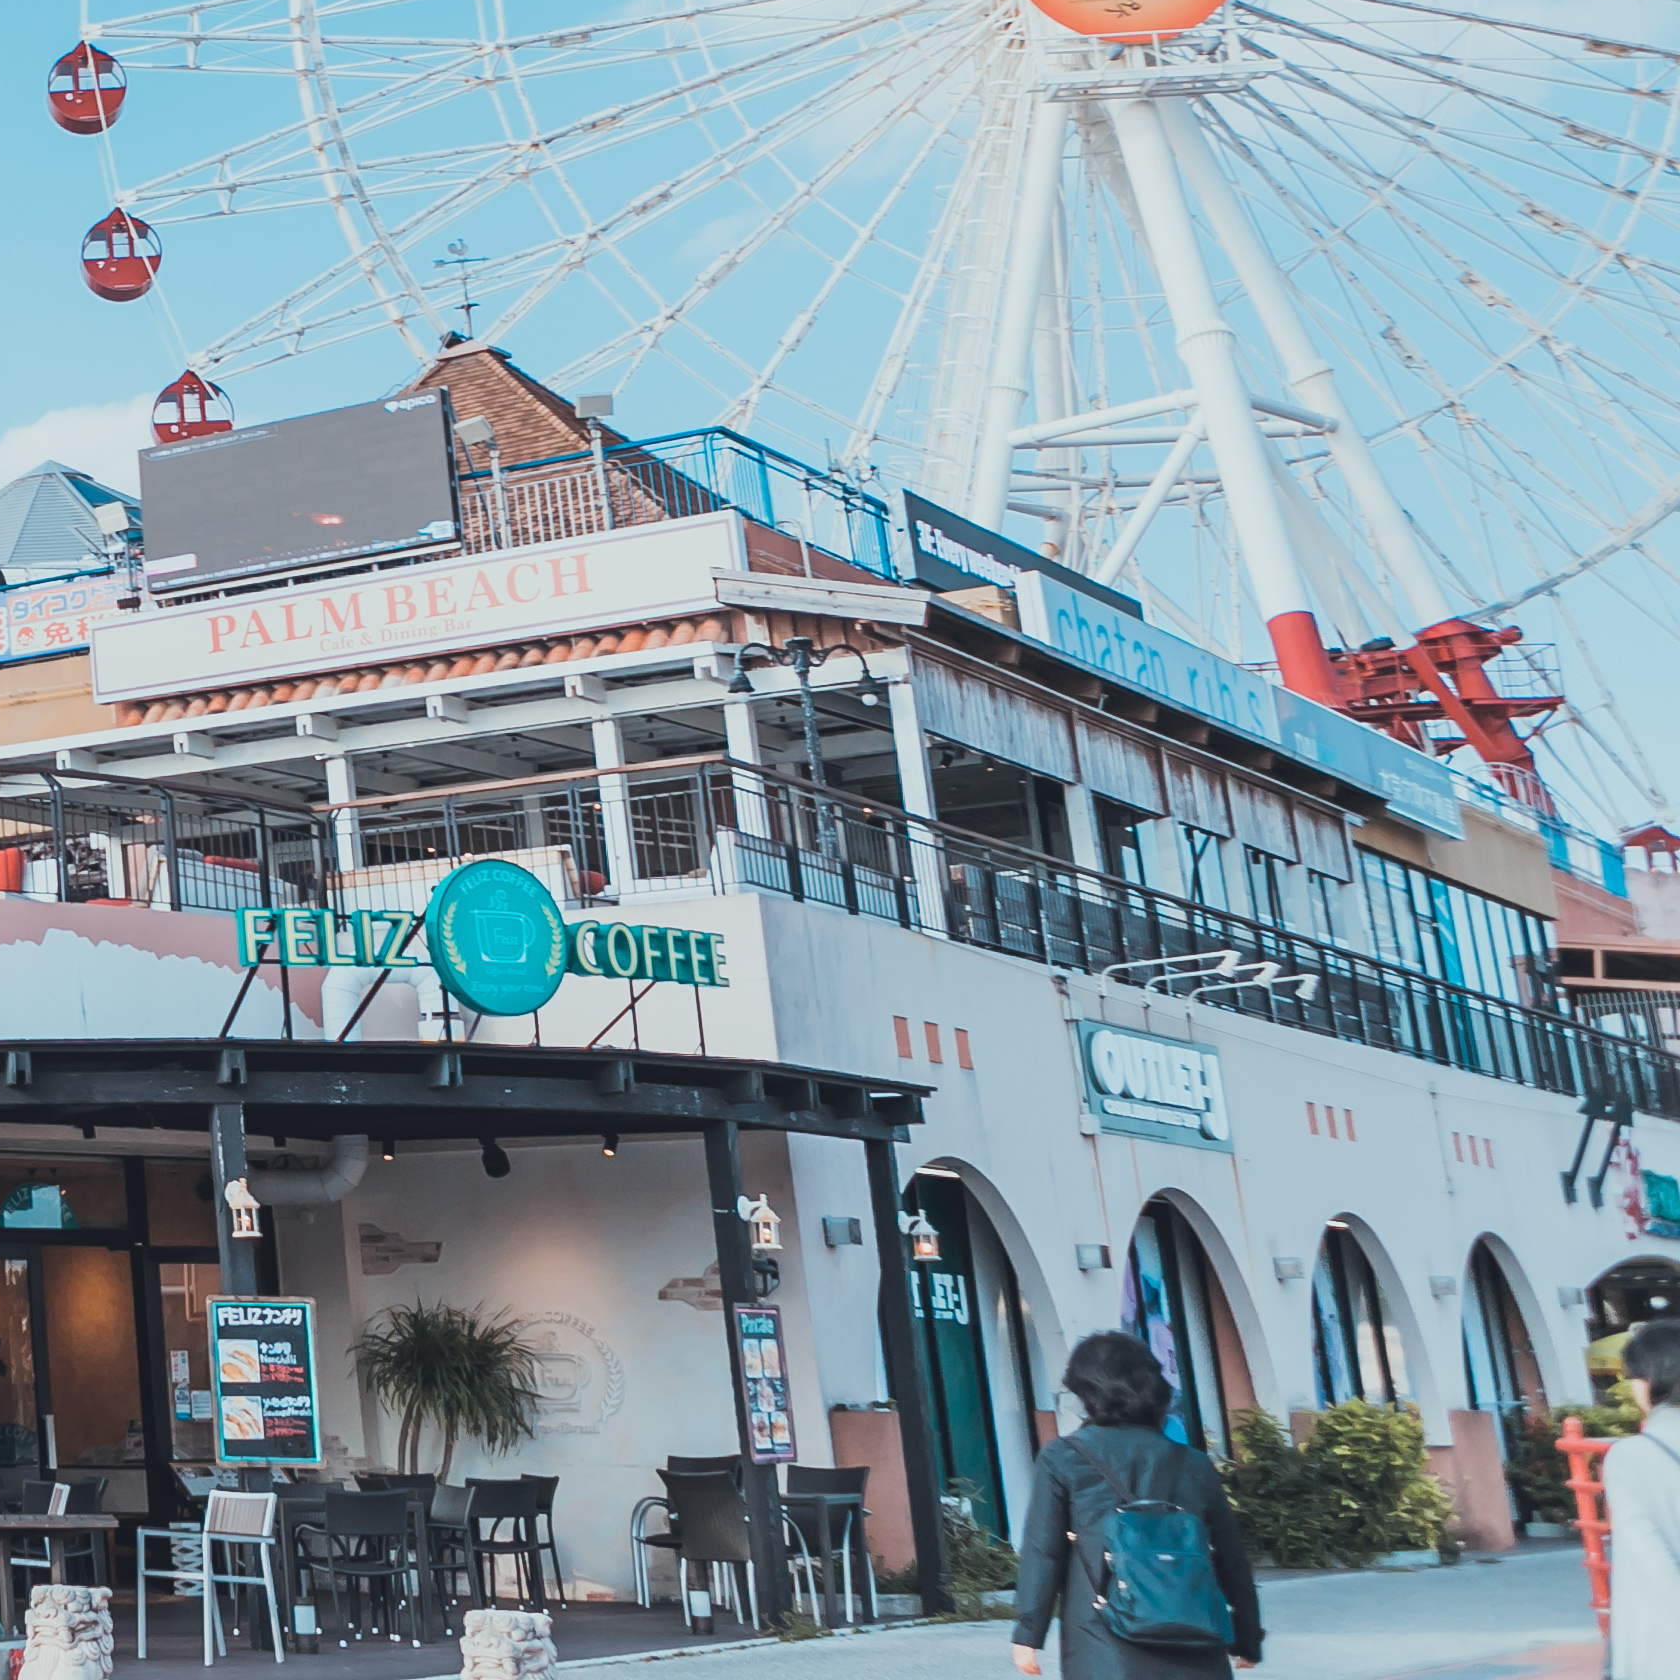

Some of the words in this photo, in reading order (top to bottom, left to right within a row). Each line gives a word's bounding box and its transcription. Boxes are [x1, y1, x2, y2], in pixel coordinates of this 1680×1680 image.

[206, 592, 366, 654] PALM
[382, 553, 594, 626] BEACH
[320, 636, 355, 653] Cafe
[380, 623, 438, 643] Dining
[444, 619, 474, 632] Bar
[1057, 591, 1170, 698] chatan
[240, 907, 418, 968] FELIZ
[567, 919, 731, 987] COFFEE
[1089, 1029, 1229, 1141] OUTLET-J
